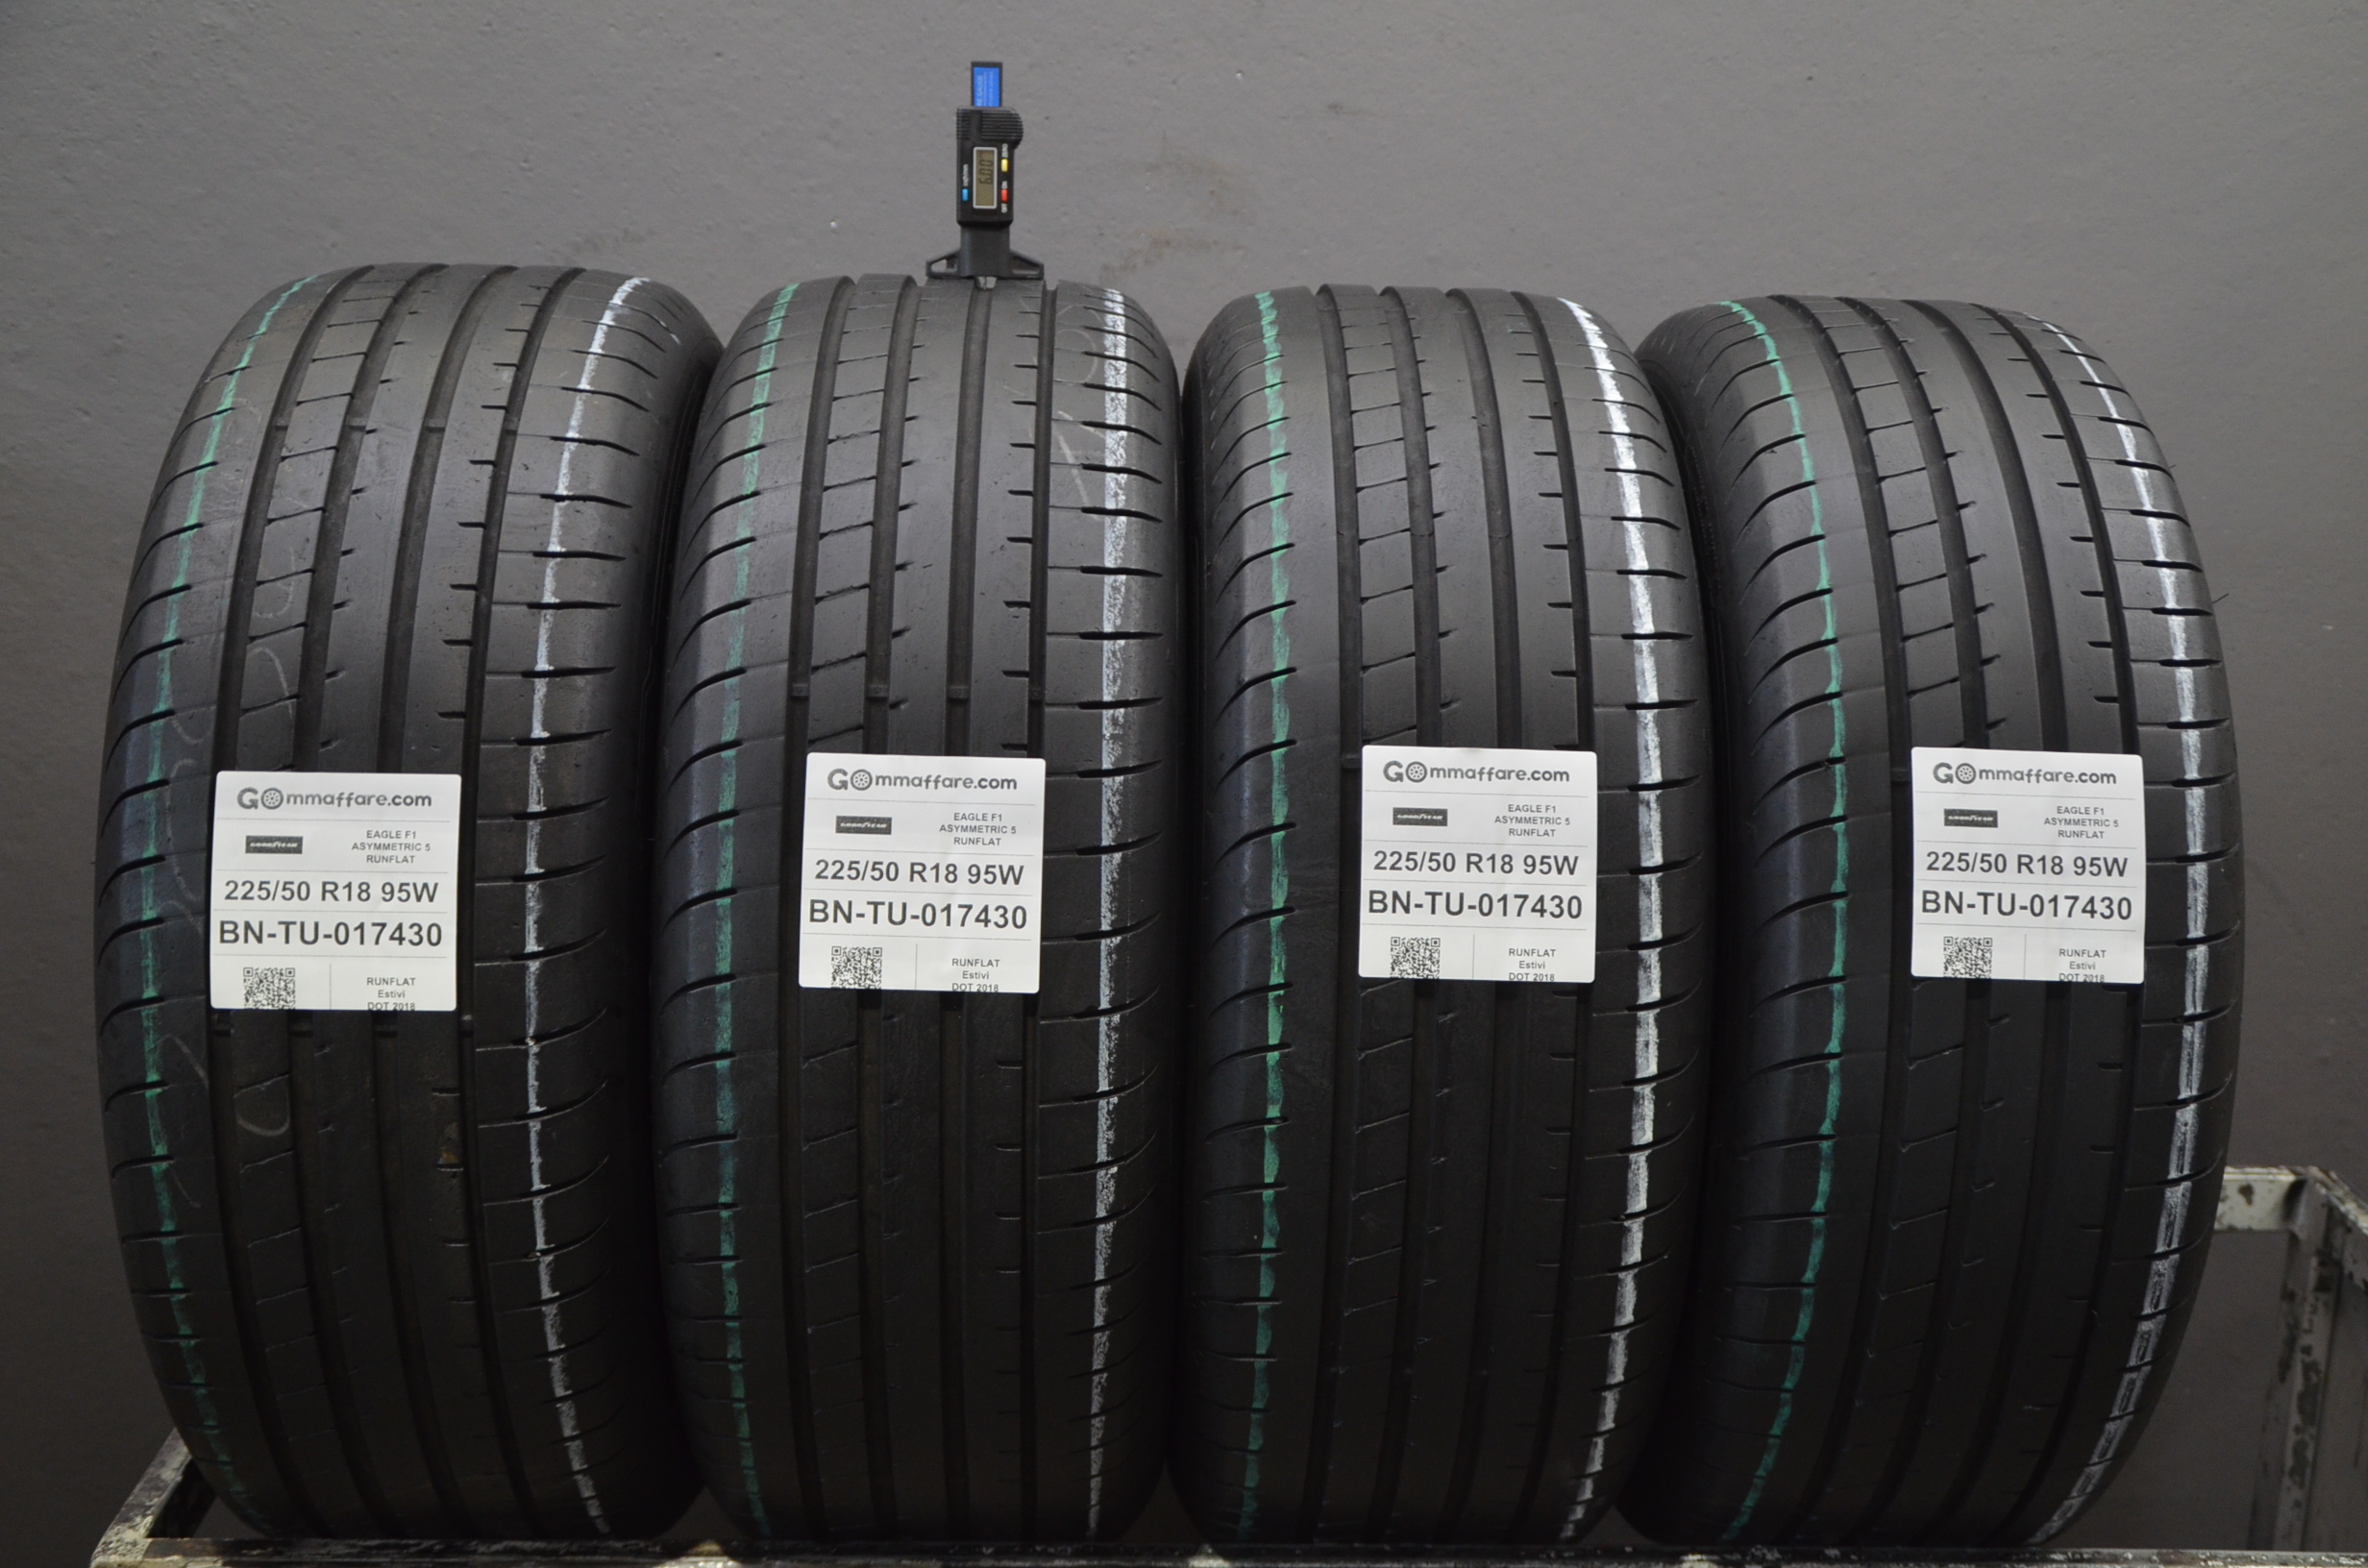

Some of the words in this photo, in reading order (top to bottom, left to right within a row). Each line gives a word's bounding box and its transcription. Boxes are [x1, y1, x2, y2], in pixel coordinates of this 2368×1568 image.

[1508, 804, 1542, 813] EAGLE
[2057, 806, 2090, 815] EAGLE
[954, 813, 988, 821] EAGLE
[1494, 816, 1562, 824] ASYMMETRIC
[2044, 818, 2109, 827] ASYMMETRIC
[939, 824, 1007, 834] ASYMMETRIC
[1509, 828, 1555, 837] RUNFLAT
[367, 830, 401, 839] EAGLE
[954, 837, 1000, 845] RUNFLAT
[352, 843, 421, 851] ASYMMETRIC
[1374, 850, 1456, 872] 225/50
[1467, 853, 1513, 873] R18
[1523, 855, 1578, 875] 95W
[1927, 851, 2007, 873] 225/50
[2017, 854, 2063, 875] R18
[2074, 856, 2128, 877] 95W
[815, 860, 899, 881] 225/50
[910, 863, 957, 883] R18
[968, 864, 1024, 885] 95W
[225, 880, 310, 901] 225/50
[322, 881, 370, 901] R18
[382, 882, 438, 902] 95W
[1369, 891, 1582, 919] BN-TU-017430
[1922, 891, 2132, 919] BN-TU-017430
[810, 899, 1026, 929] BN-TU-017430
[220, 920, 441, 946] BN-TU-017430
[1509, 948, 1556, 957] RUNFLAT
[2060, 948, 2106, 958] RUNFLAT
[2069, 961, 2095, 969] Estivi
[963, 970, 989, 979] Estivi
[1509, 972, 1531, 981] DOT
[2059, 973, 2081, 982] DOT
[2084, 974, 2105, 983] 2018
[367, 977, 415, 986] RUNFLAT
[952, 983, 974, 992] DOT
[976, 984, 999, 992] 2018
[378, 990, 405, 998] Estivi
[392, 1002, 415, 1011] 2018
